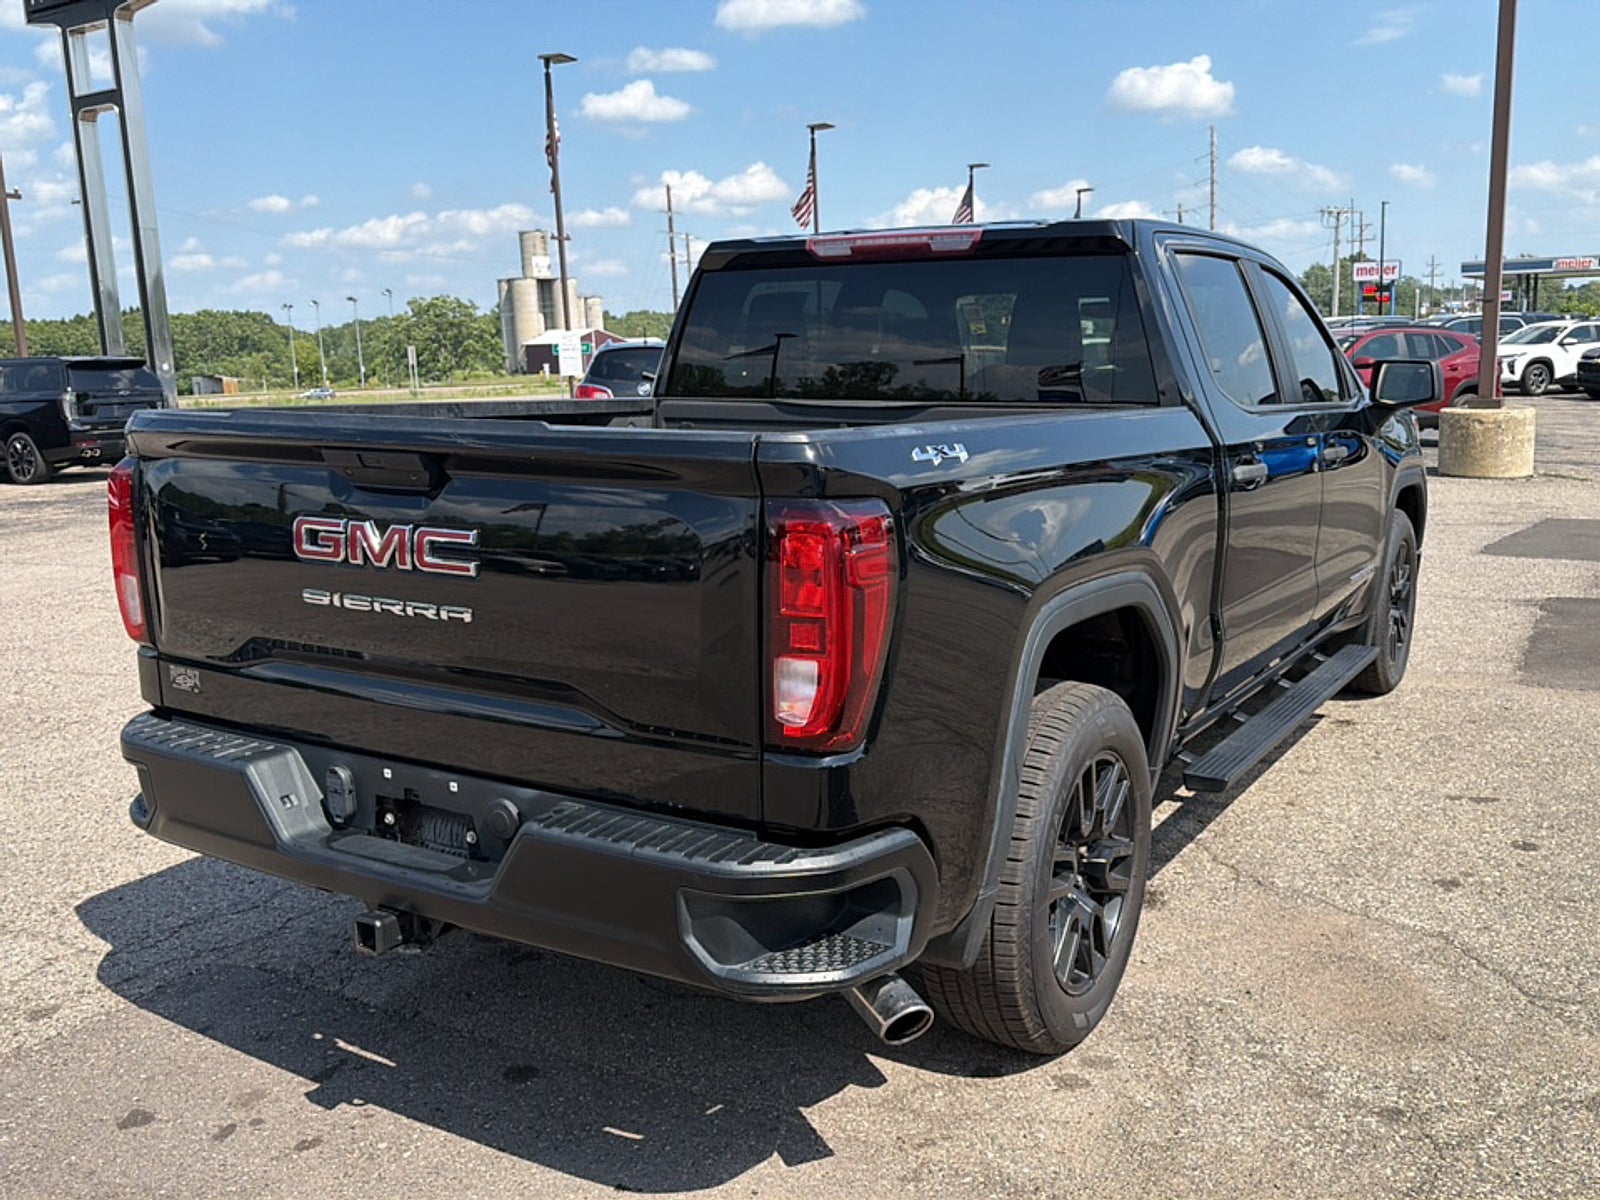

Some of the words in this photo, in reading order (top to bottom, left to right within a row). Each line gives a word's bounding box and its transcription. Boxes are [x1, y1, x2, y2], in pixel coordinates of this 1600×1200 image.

[1356, 264, 1397, 277] meier
[293, 516, 481, 577] GMC
[302, 588, 474, 623] SIERRA
